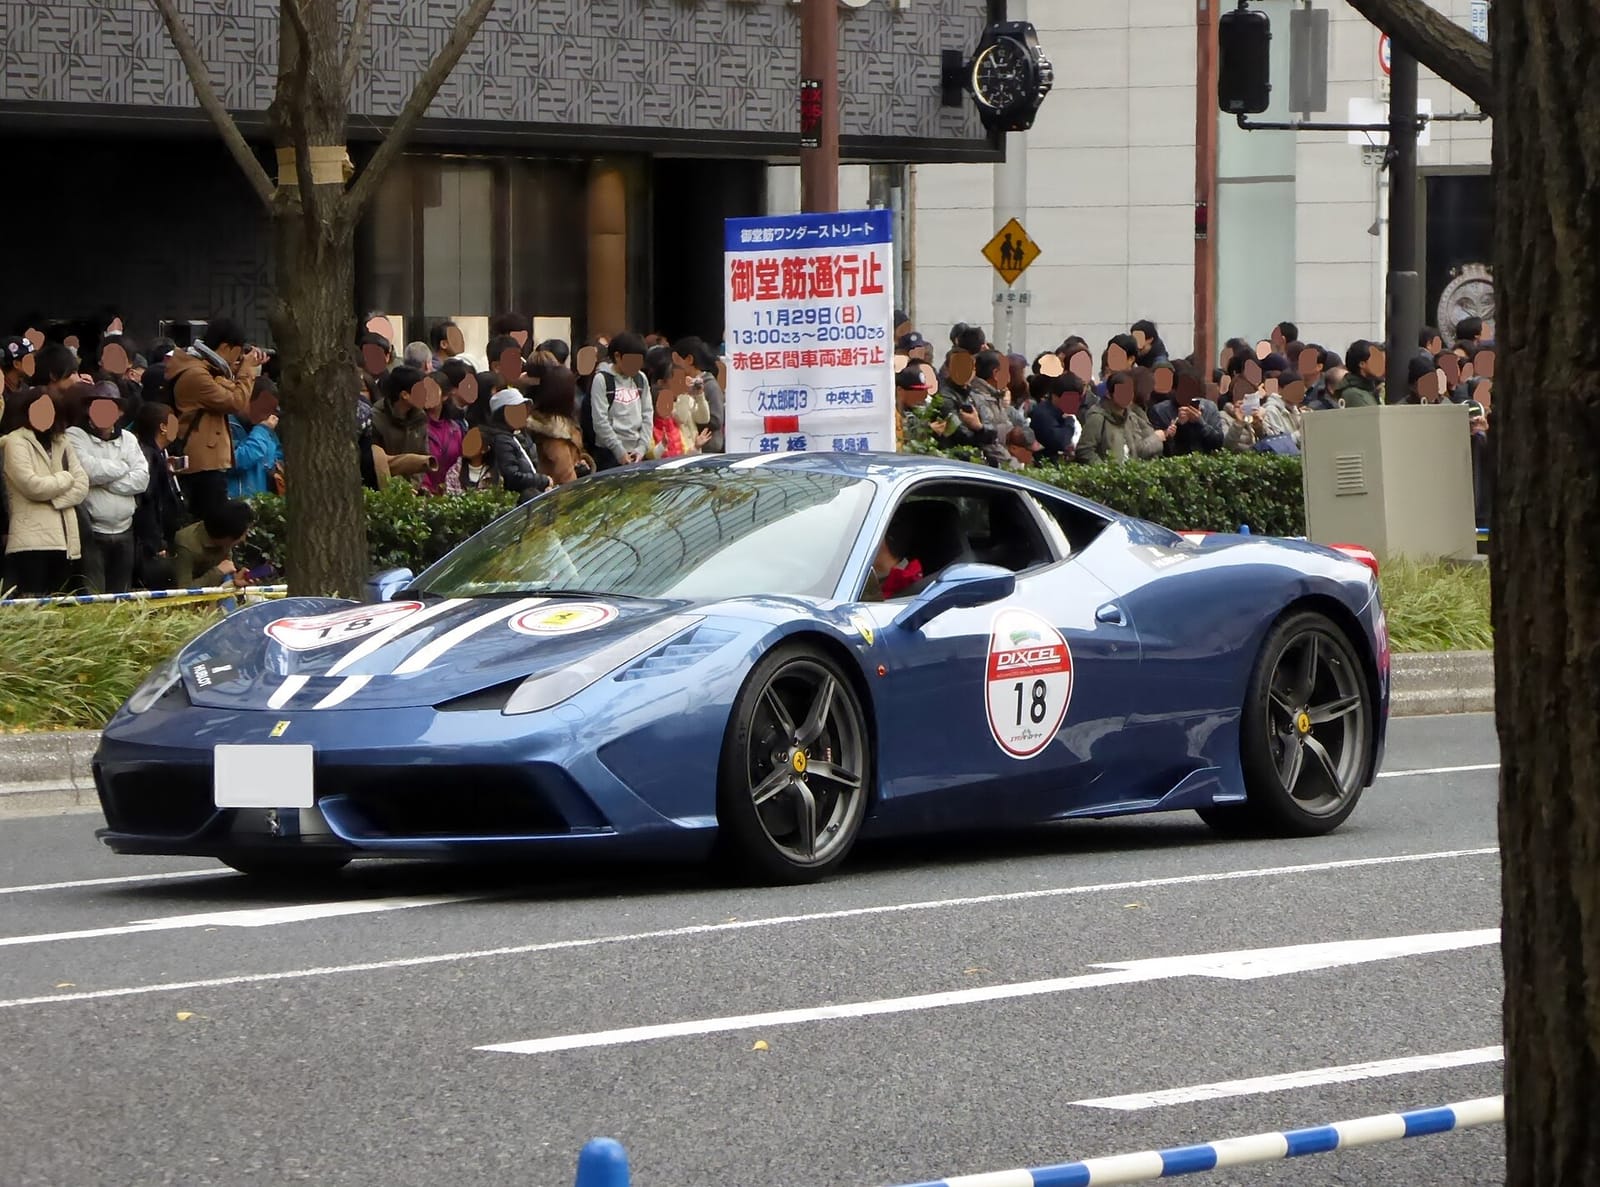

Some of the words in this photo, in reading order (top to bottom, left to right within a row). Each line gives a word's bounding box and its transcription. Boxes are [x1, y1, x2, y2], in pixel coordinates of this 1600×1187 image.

[741, 222, 874, 243] 御堂筋ワンダーストリート
[731, 252, 883, 302] 御堂筋通行止
[732, 346, 885, 370] 赤色区間車両通行止
[758, 389, 808, 411] 久太郎町3
[825, 388, 874, 405] 中央大通
[318, 618, 373, 639] 18
[997, 648, 1062, 667] DIXCEL
[193, 663, 212, 688] HUBLOT
[1014, 679, 1047, 726] 18
